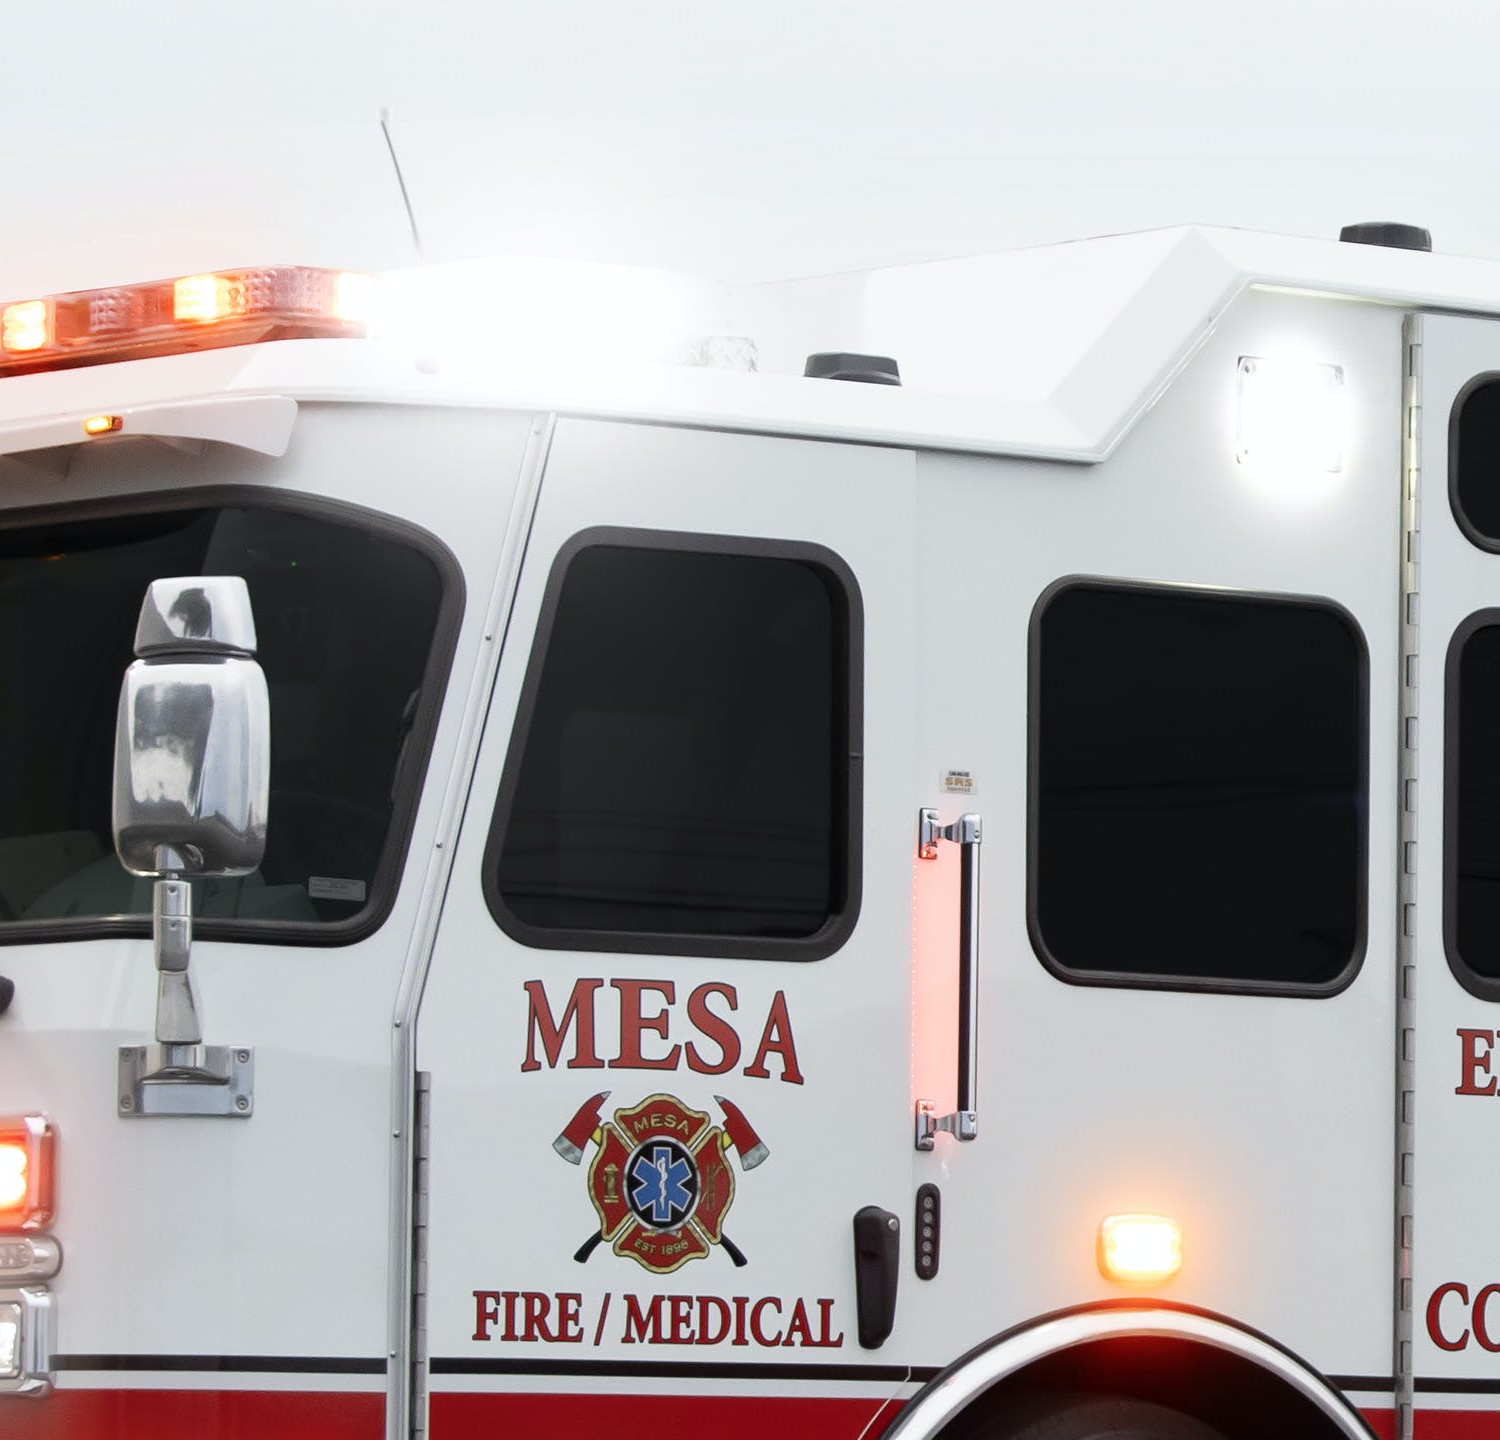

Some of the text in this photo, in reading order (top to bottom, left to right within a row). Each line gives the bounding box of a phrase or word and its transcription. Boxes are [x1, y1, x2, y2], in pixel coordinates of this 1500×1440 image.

[521, 978, 804, 1085] MESA
[633, 1113, 689, 1135] MESA
[634, 1238, 690, 1256] EST 1898
[472, 1290, 584, 1344] FIRE
[621, 1294, 844, 1348] MEDICAL
